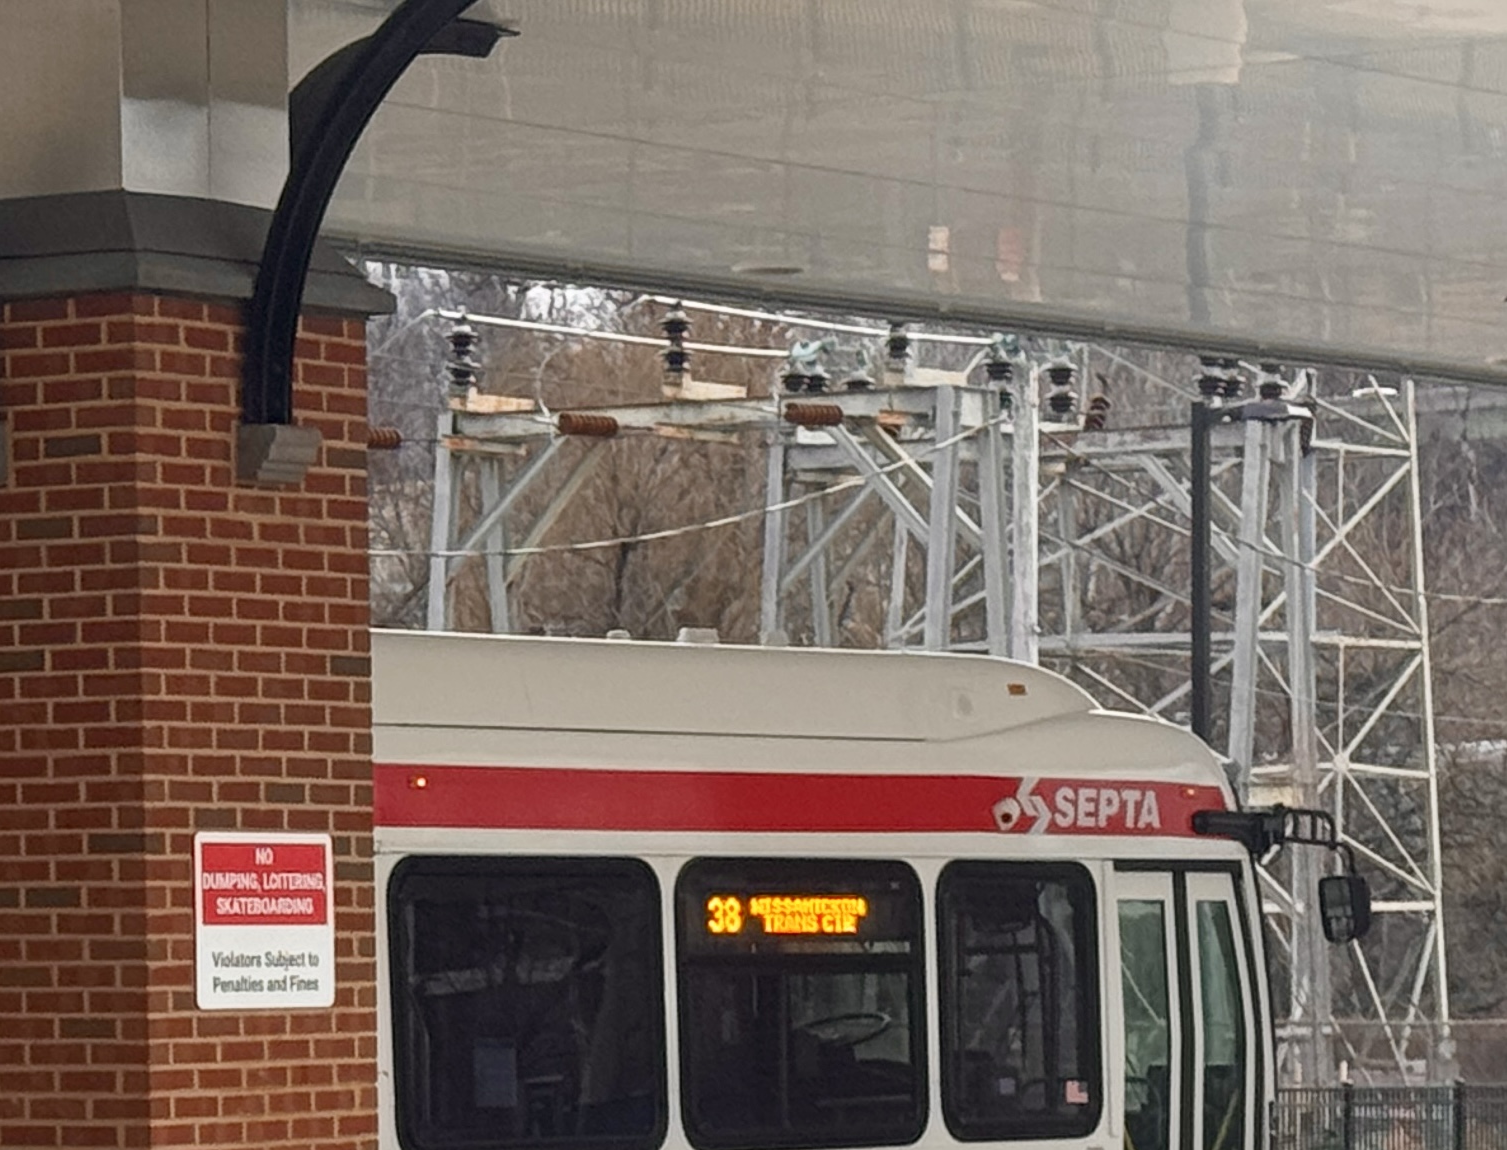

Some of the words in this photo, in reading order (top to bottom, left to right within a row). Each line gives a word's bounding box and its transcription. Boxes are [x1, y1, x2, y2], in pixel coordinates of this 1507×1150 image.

[1054, 786, 1161, 829] SEPTA
[255, 847, 274, 865] NO
[202, 872, 261, 892] DUMPING,
[263, 872, 326, 891] LOITERING,
[216, 897, 314, 915] SKATEBOARDING
[707, 896, 742, 934] 38
[764, 915, 819, 933] TRANS
[212, 952, 262, 968] Violators
[264, 951, 306, 971] Subject
[308, 952, 319, 967] to
[213, 976, 264, 993] Penalties
[267, 976, 287, 992] and
[289, 976, 319, 991] Fines
